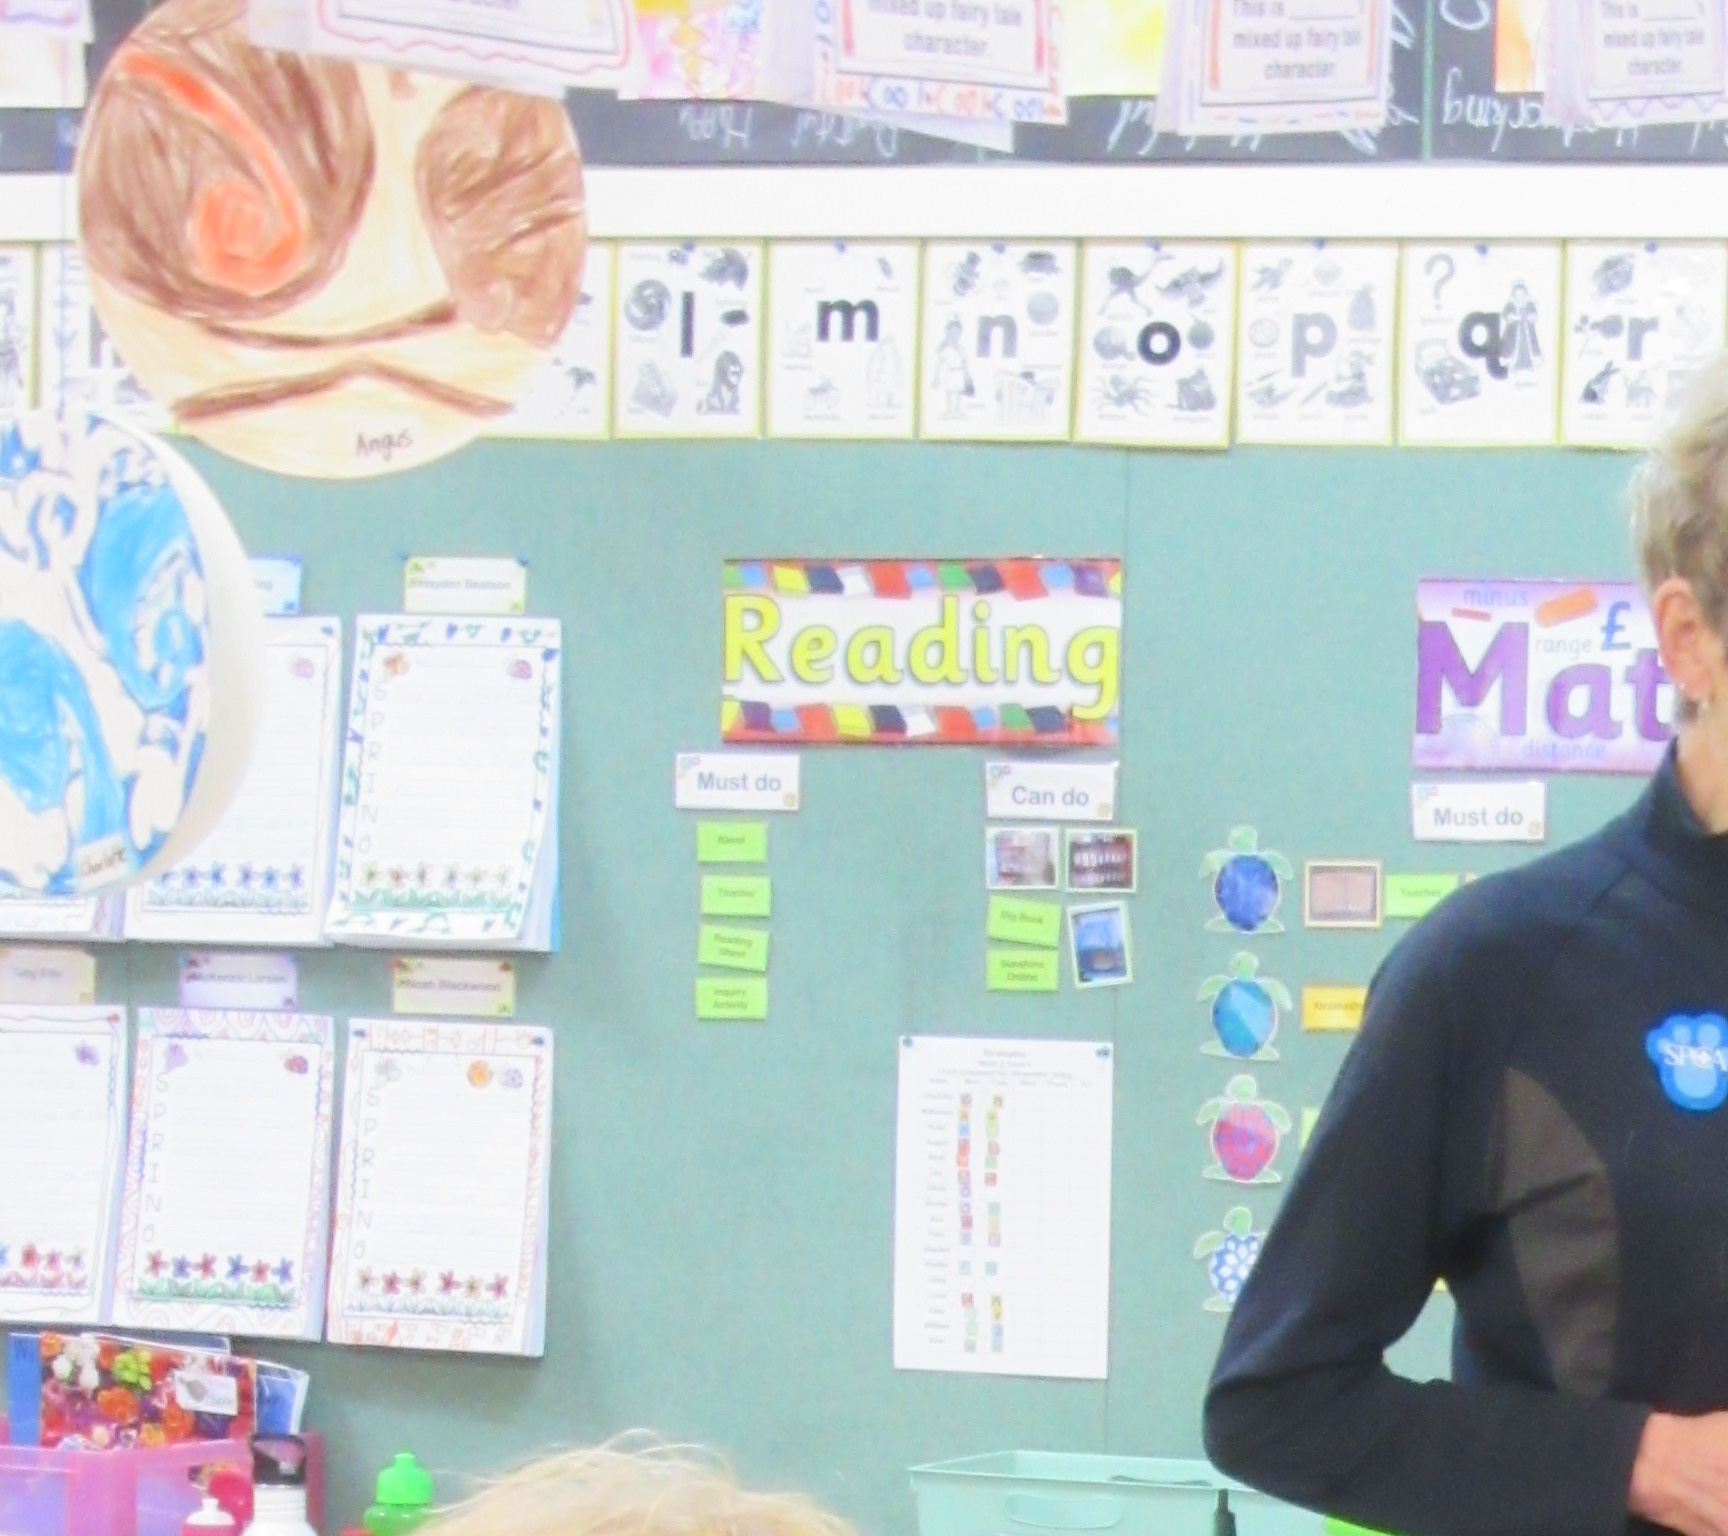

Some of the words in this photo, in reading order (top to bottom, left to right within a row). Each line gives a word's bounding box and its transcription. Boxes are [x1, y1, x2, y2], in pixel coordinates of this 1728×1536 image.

[1233, 29, 1281, 50] mixed
[1285, 32, 1303, 52] up
[1306, 29, 1341, 54] fairy
[1603, 31, 1637, 49] mixed
[815, 298, 881, 343] m
[975, 312, 1019, 359] n
[1627, 315, 1661, 361] r
[1135, 319, 1183, 367] o
[1291, 312, 1338, 378] p
[1457, 311, 1509, 380] q
[355, 429, 415, 462] Angus
[1463, 584, 1529, 607] minus
[1534, 636, 1593, 661] range
[1599, 600, 1632, 650] £
[723, 593, 1121, 720] Reading
[1522, 741, 1607, 760] distance
[698, 770, 750, 793] Must
[754, 771, 782, 793] do
[1010, 785, 1057, 808] Can
[1060, 786, 1090, 808] do
[1433, 805, 1489, 828] Must
[1495, 805, 1525, 828] do
